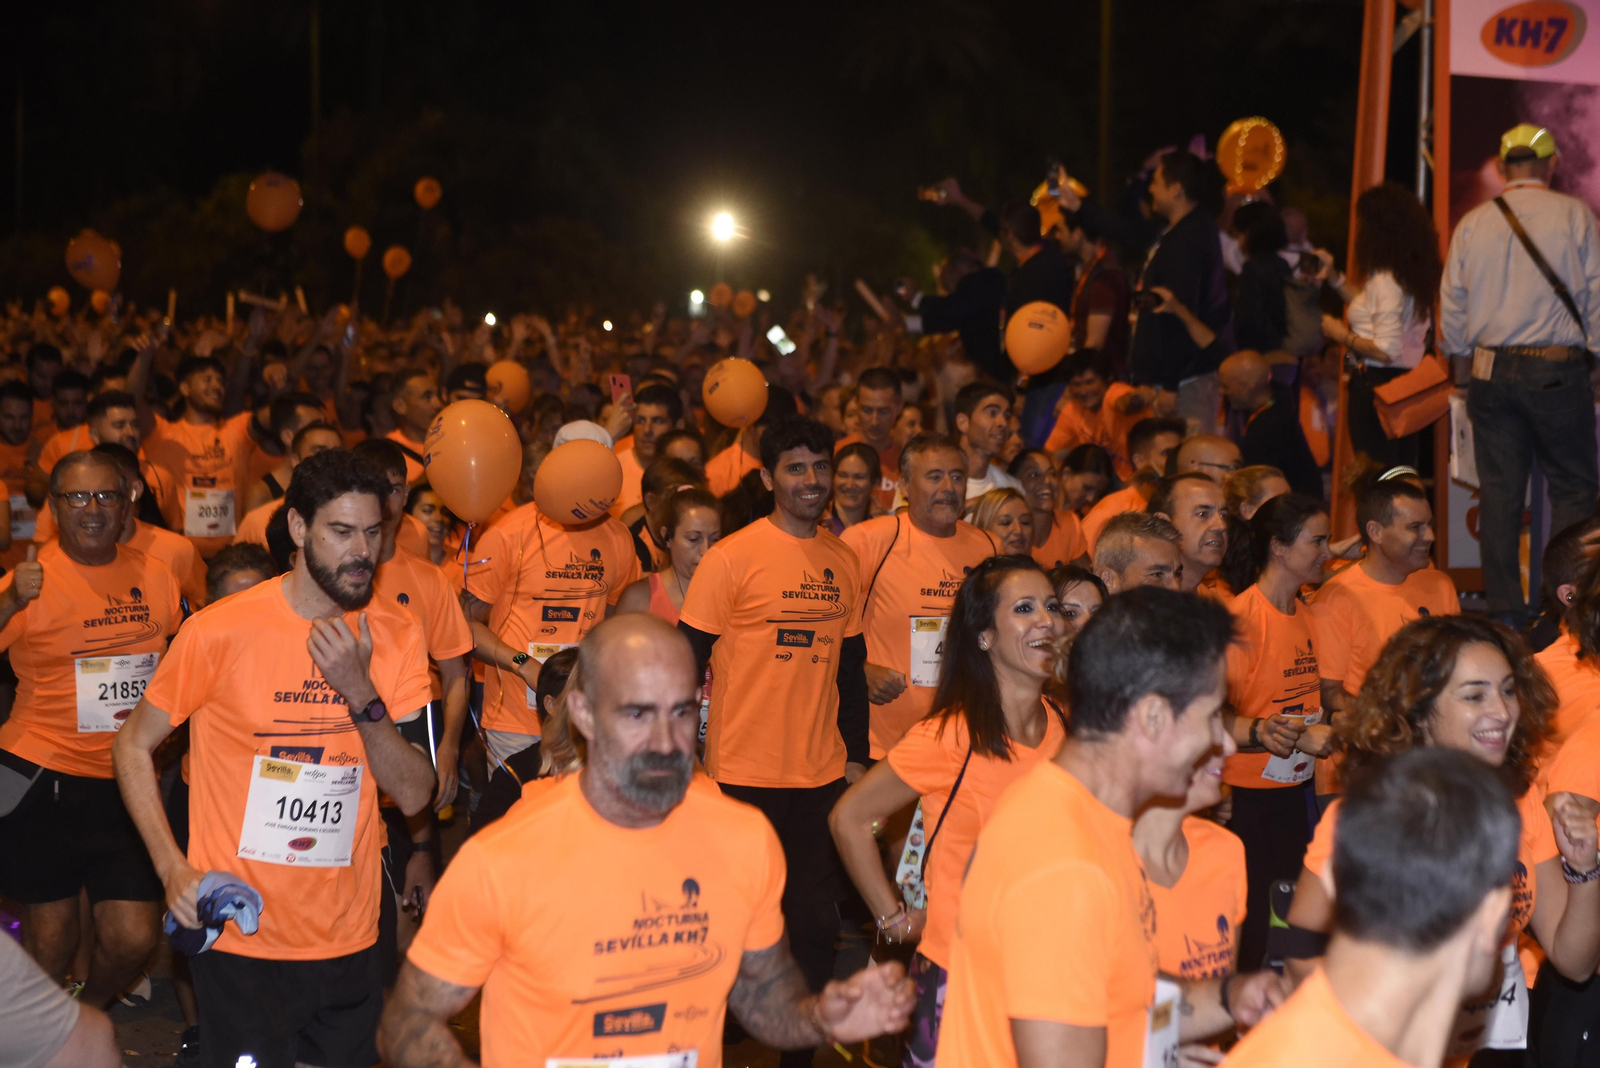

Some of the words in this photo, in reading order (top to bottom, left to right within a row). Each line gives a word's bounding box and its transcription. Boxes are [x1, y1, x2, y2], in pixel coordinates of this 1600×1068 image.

[564, 563, 605, 572] NOCTURNA
[545, 570, 583, 579] SEVILLA
[782, 590, 819, 600] SEVILLA
[800, 583, 841, 594] NOCTURNA
[105, 605, 150, 616] NOCTURNA
[83, 615, 128, 628] SEVILLA
[98, 679, 147, 701] 21853
[273, 690, 329, 704] SEVILLA
[276, 796, 343, 825] 10413
[633, 912, 709, 930] NOCTURNA
[594, 931, 669, 955] SEVILLA
